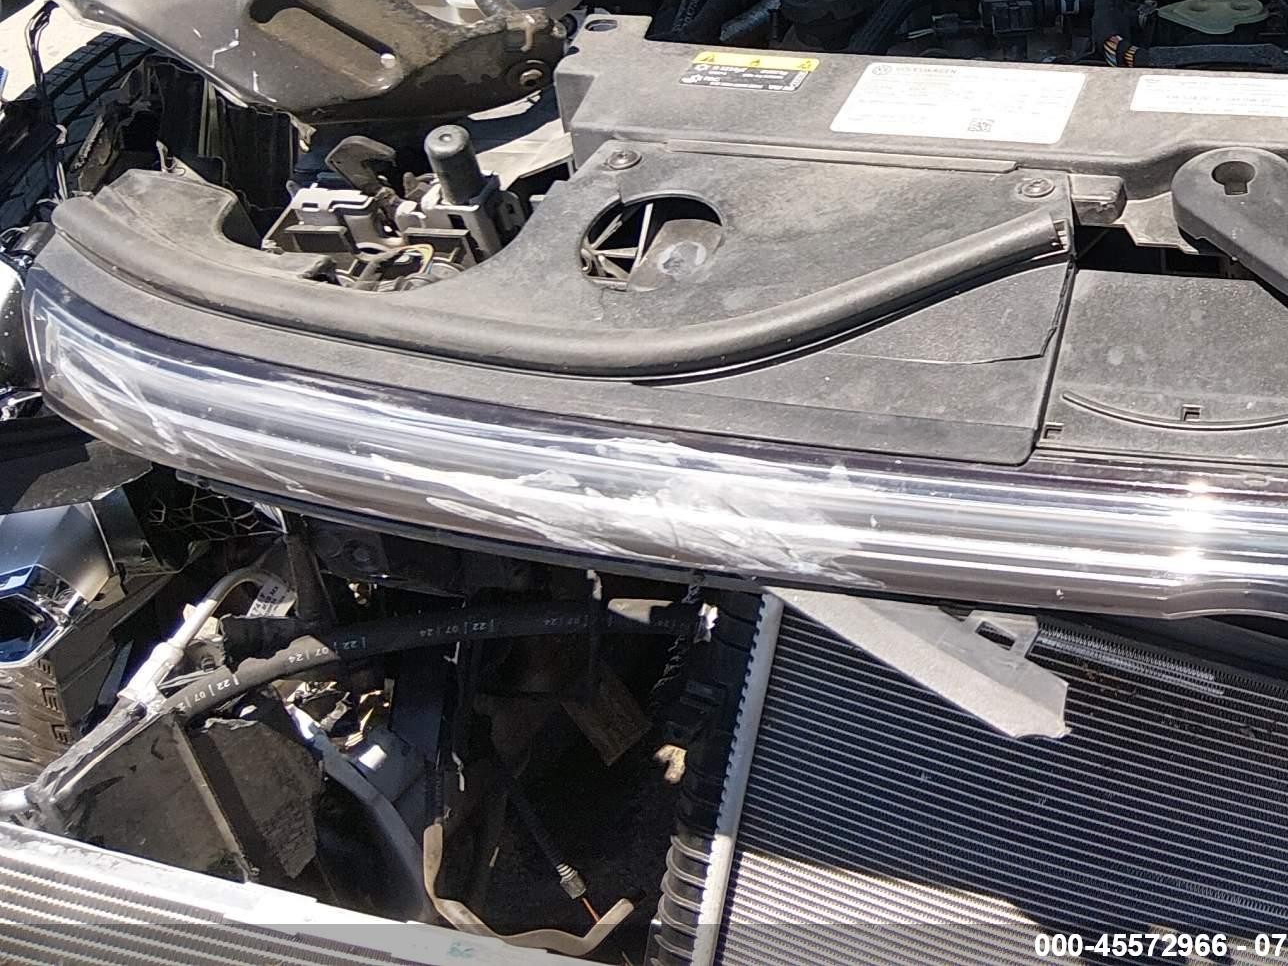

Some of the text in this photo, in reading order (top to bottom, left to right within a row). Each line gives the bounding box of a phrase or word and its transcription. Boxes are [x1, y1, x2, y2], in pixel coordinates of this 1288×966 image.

[444, 624, 459, 634] 07
[471, 621, 488, 632] 22
[342, 639, 358, 650] 22
[287, 652, 304, 664] 24
[315, 646, 329, 658] 07
[216, 678, 231, 691] 22
[193, 690, 206, 702] 07
